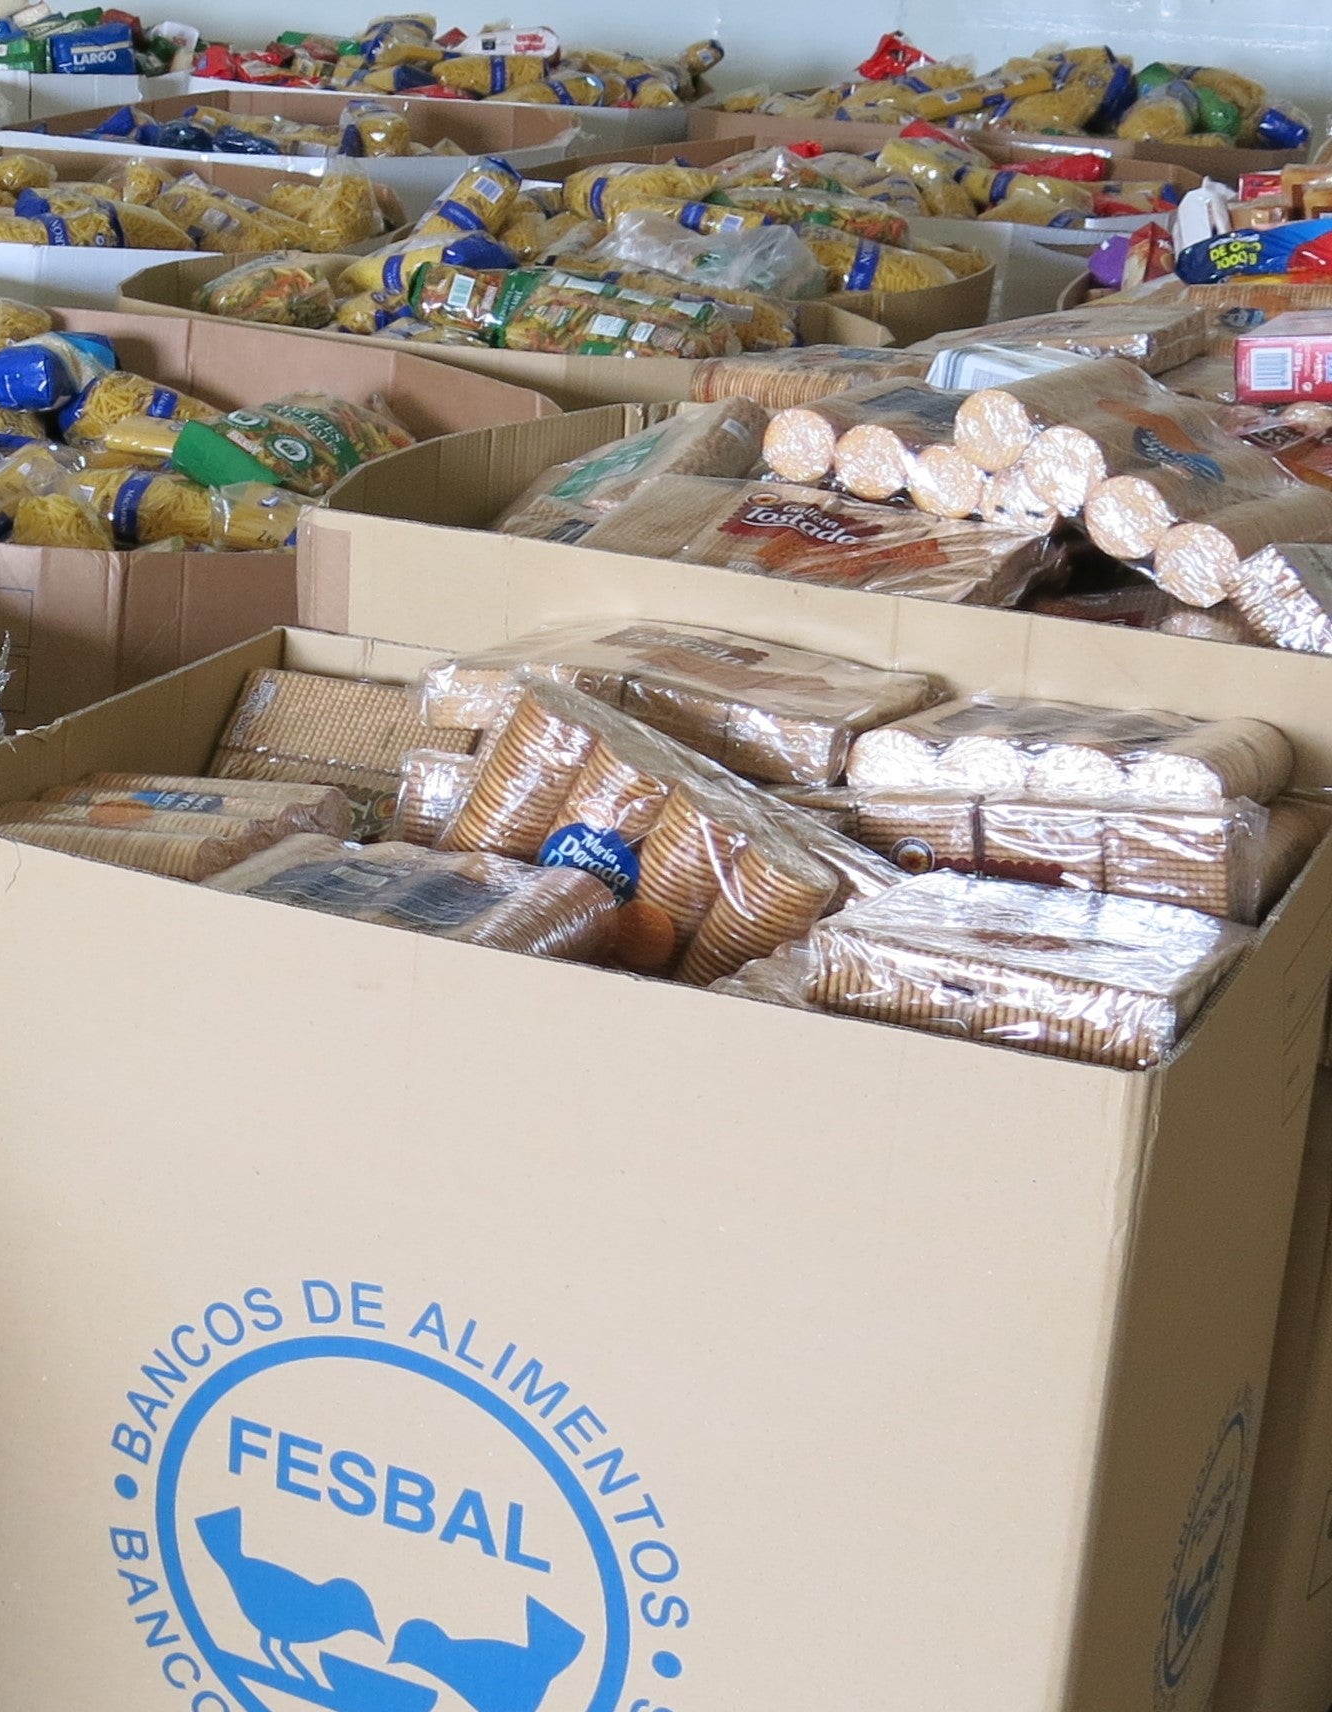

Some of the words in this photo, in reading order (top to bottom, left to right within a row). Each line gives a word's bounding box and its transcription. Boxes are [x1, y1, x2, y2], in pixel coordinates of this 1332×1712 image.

[73, 51, 117, 65] LARGO
[558, 834, 631, 888] Dorada
[110, 1287, 285, 1466] BANCOS
[301, 1278, 387, 1331] DE
[408, 1300, 691, 1633] ALIMENTOS
[227, 1416, 552, 1574] FESBAL
[109, 1526, 231, 1712] BANCO
